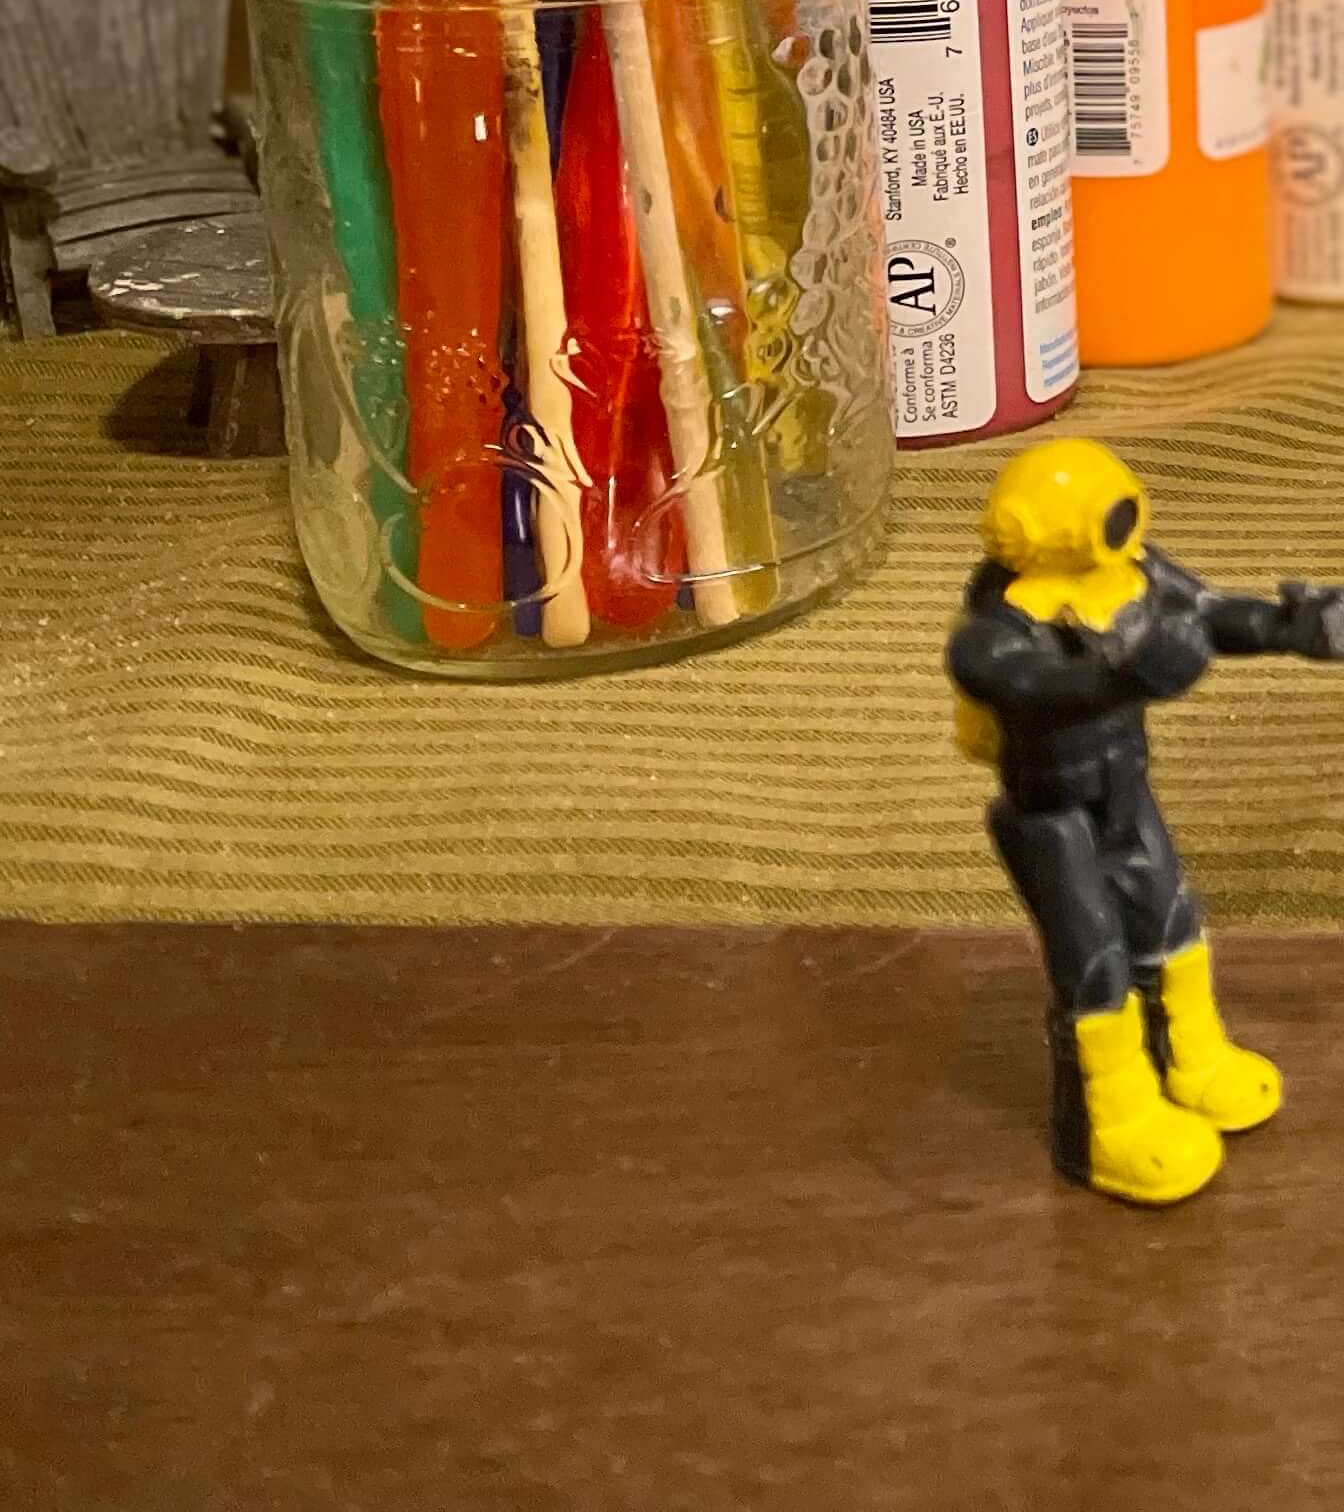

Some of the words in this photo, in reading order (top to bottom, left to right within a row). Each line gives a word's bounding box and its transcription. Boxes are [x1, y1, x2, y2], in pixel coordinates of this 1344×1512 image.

[945, 46, 962, 58] 7
[878, 78, 895, 105] USA
[928, 92, 944, 122] E.-U.
[880, 109, 897, 144] 40484
[908, 109, 925, 136] USA
[933, 125, 945, 146] aux
[882, 147, 898, 164] KY
[911, 139, 925, 150] in
[955, 139, 967, 153] en
[911, 153, 927, 186] Made
[931, 149, 950, 202] Fabriqué
[952, 156, 969, 195] Hecho
[884, 167, 902, 221] Stanford,
[888, 257, 936, 316] AP
[938, 333, 957, 375] D4236
[920, 341, 935, 403] conforma
[902, 359, 918, 424] Conforme
[941, 380, 958, 419] ASTM
[921, 406, 936, 421] Se
